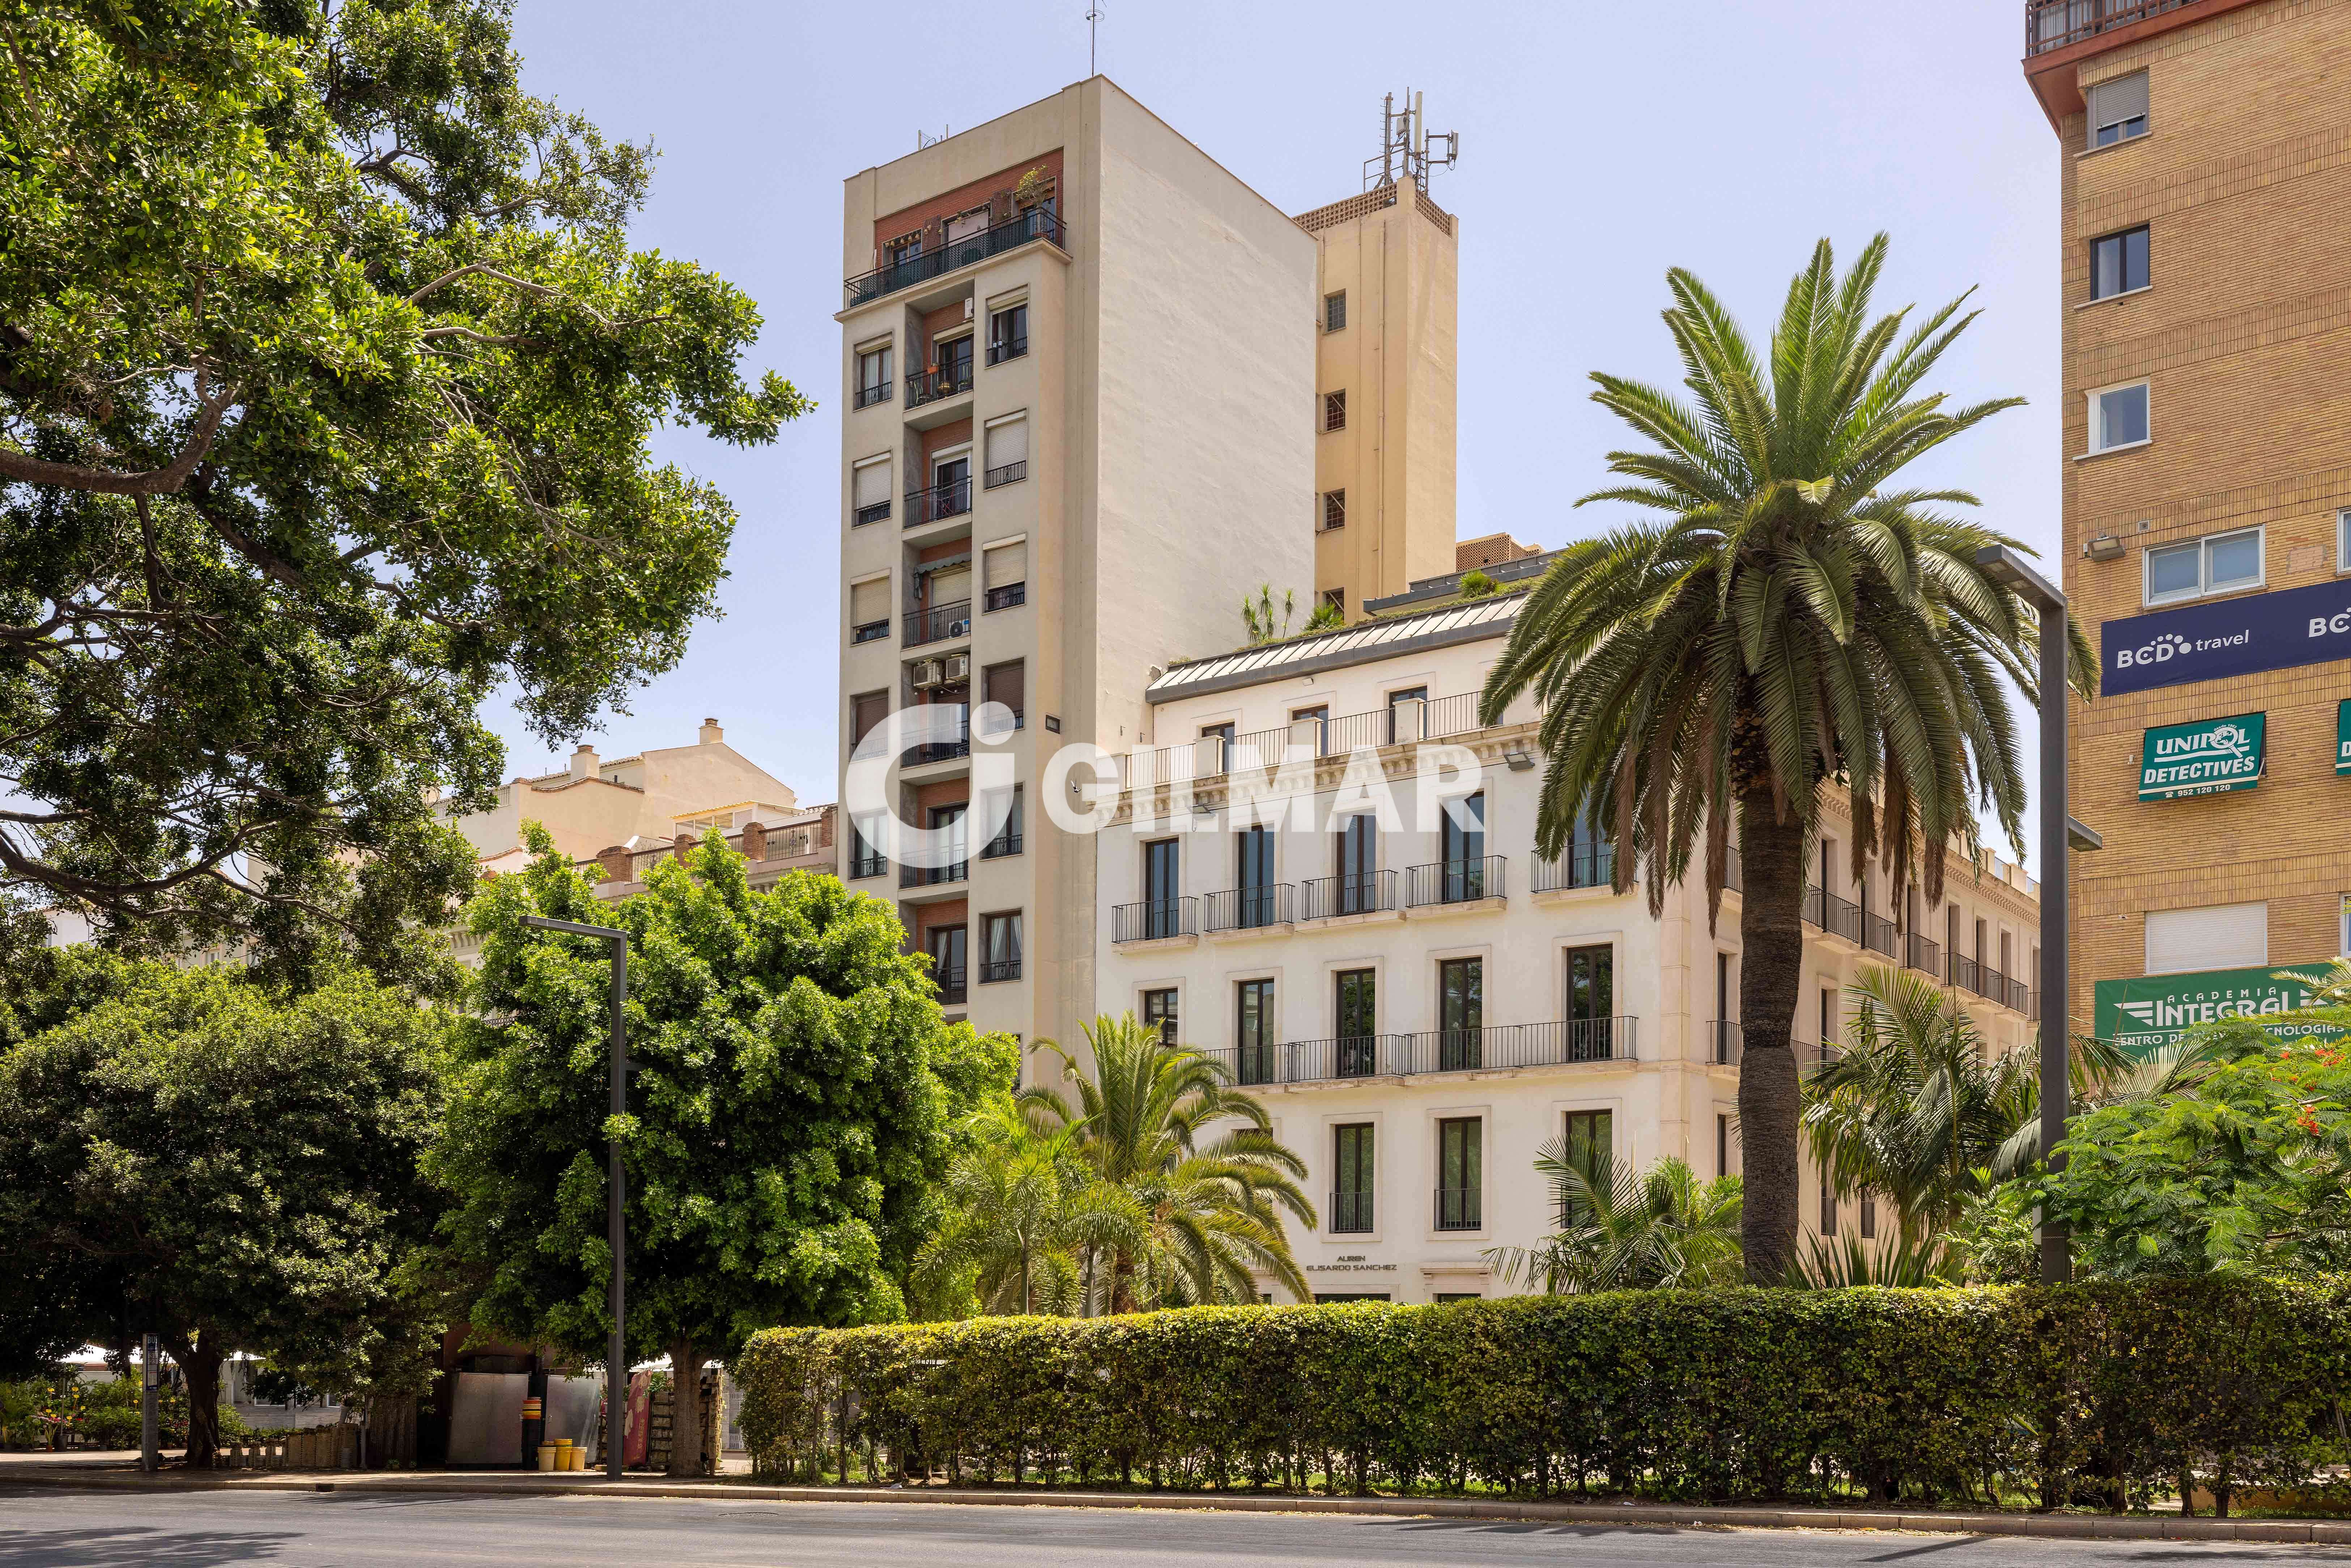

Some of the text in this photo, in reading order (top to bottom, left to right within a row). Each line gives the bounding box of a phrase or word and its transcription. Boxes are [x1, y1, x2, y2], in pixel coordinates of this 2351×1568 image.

[2309, 613, 2351, 637] BC
[2117, 629, 2249, 668] BCD travel
[2156, 727, 2250, 755] UNIPOL
[2144, 756, 2254, 784] DETECTIVES
[2167, 987, 2276, 1003] ACADEMIA
[2115, 1035, 2163, 1046] CENTRO
